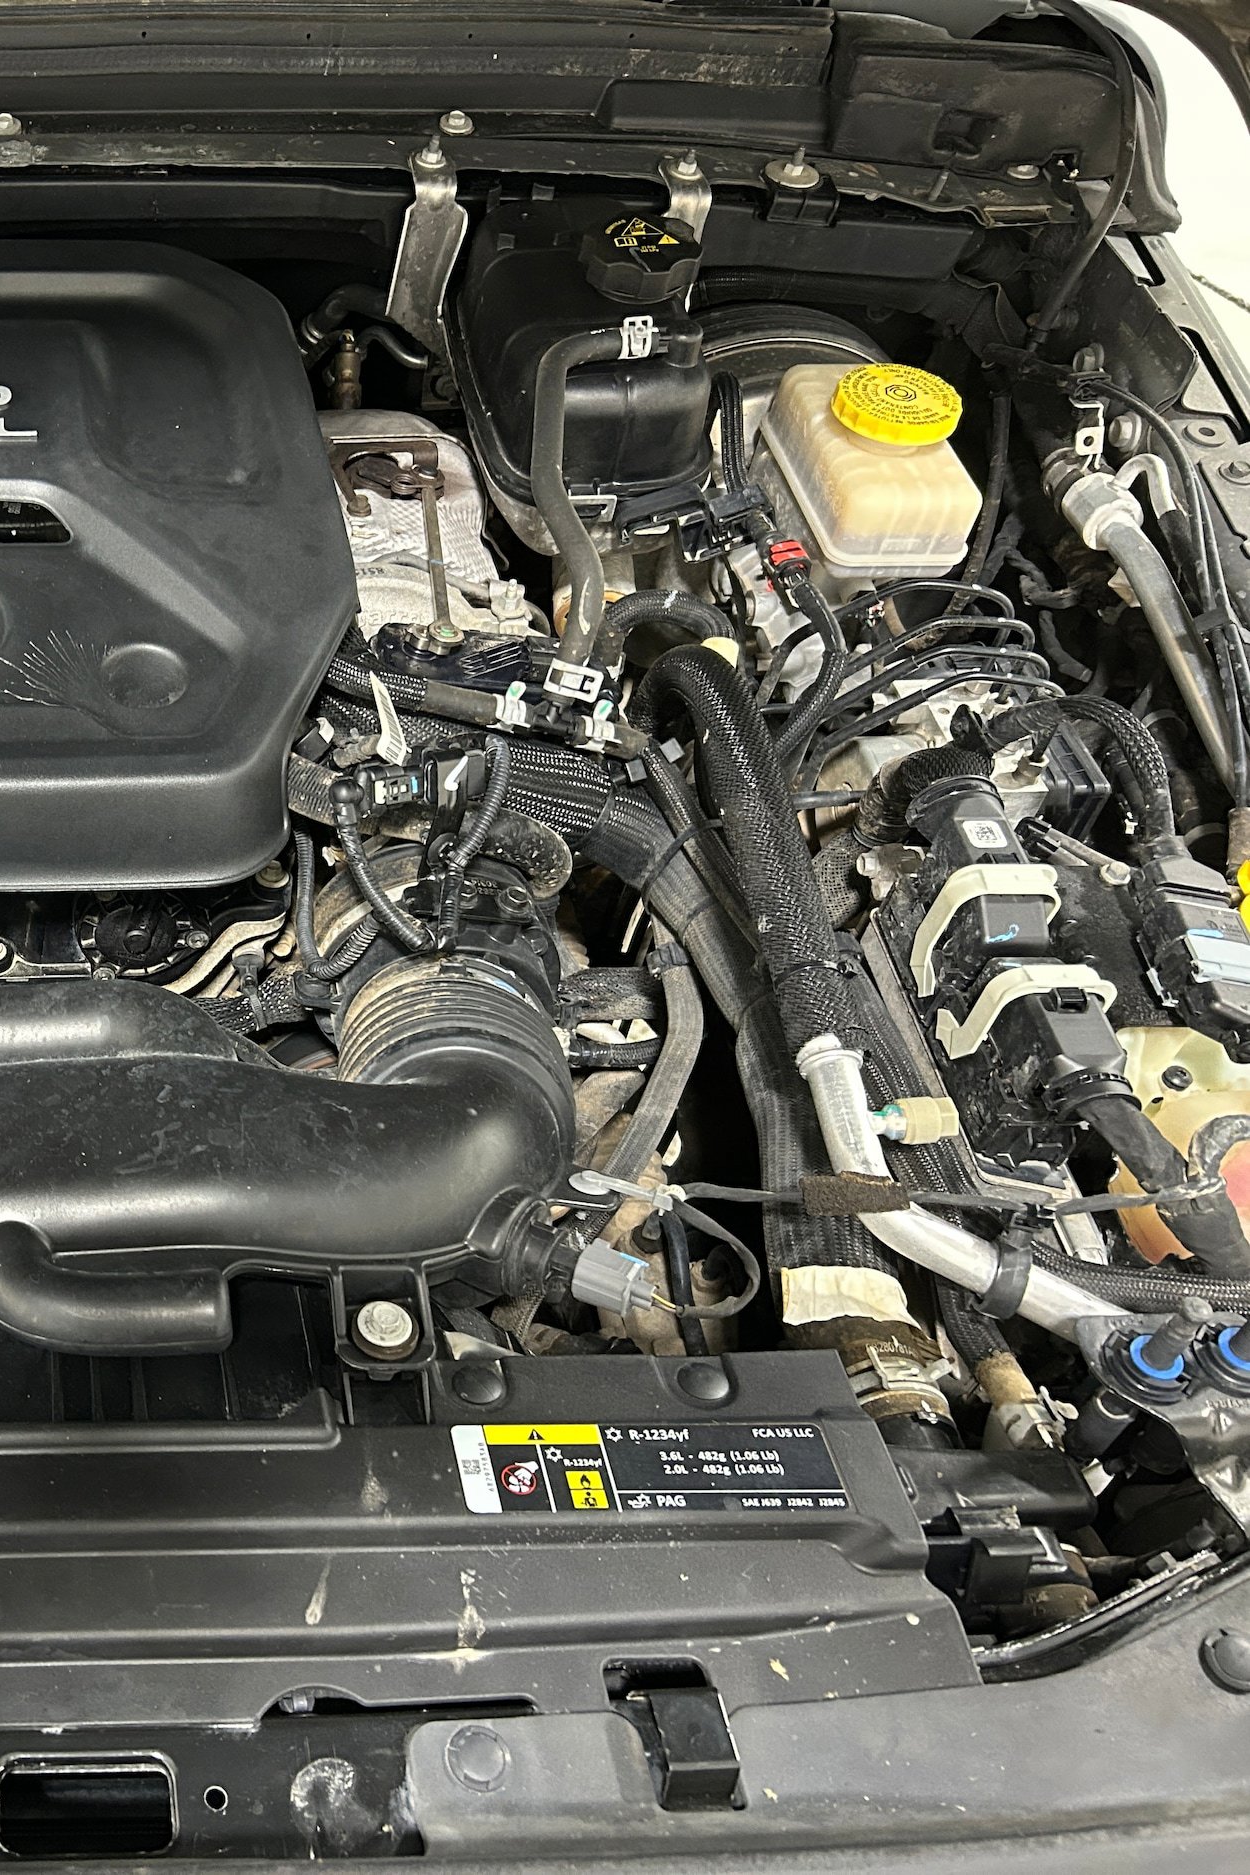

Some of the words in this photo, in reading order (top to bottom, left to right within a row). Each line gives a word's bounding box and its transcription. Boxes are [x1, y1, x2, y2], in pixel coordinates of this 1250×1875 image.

[628, 1429, 690, 1442] R-1234yf
[752, 1428, 776, 1438] FCA
[776, 1428, 792, 1438] US
[793, 1428, 815, 1438] LLC
[659, 1450, 685, 1461] 3.6L
[698, 1451, 727, 1463] 482g
[730, 1450, 758, 1462] (1.06
[760, 1450, 780, 1462] Lb)
[663, 1464, 689, 1475] 2.0L
[702, 1465, 731, 1477] 482g
[734, 1464, 764, 1476] (1.06
[766, 1464, 785, 1476] Lb)
[656, 1495, 687, 1507] PAG
[741, 1499, 760, 1507] SAE
